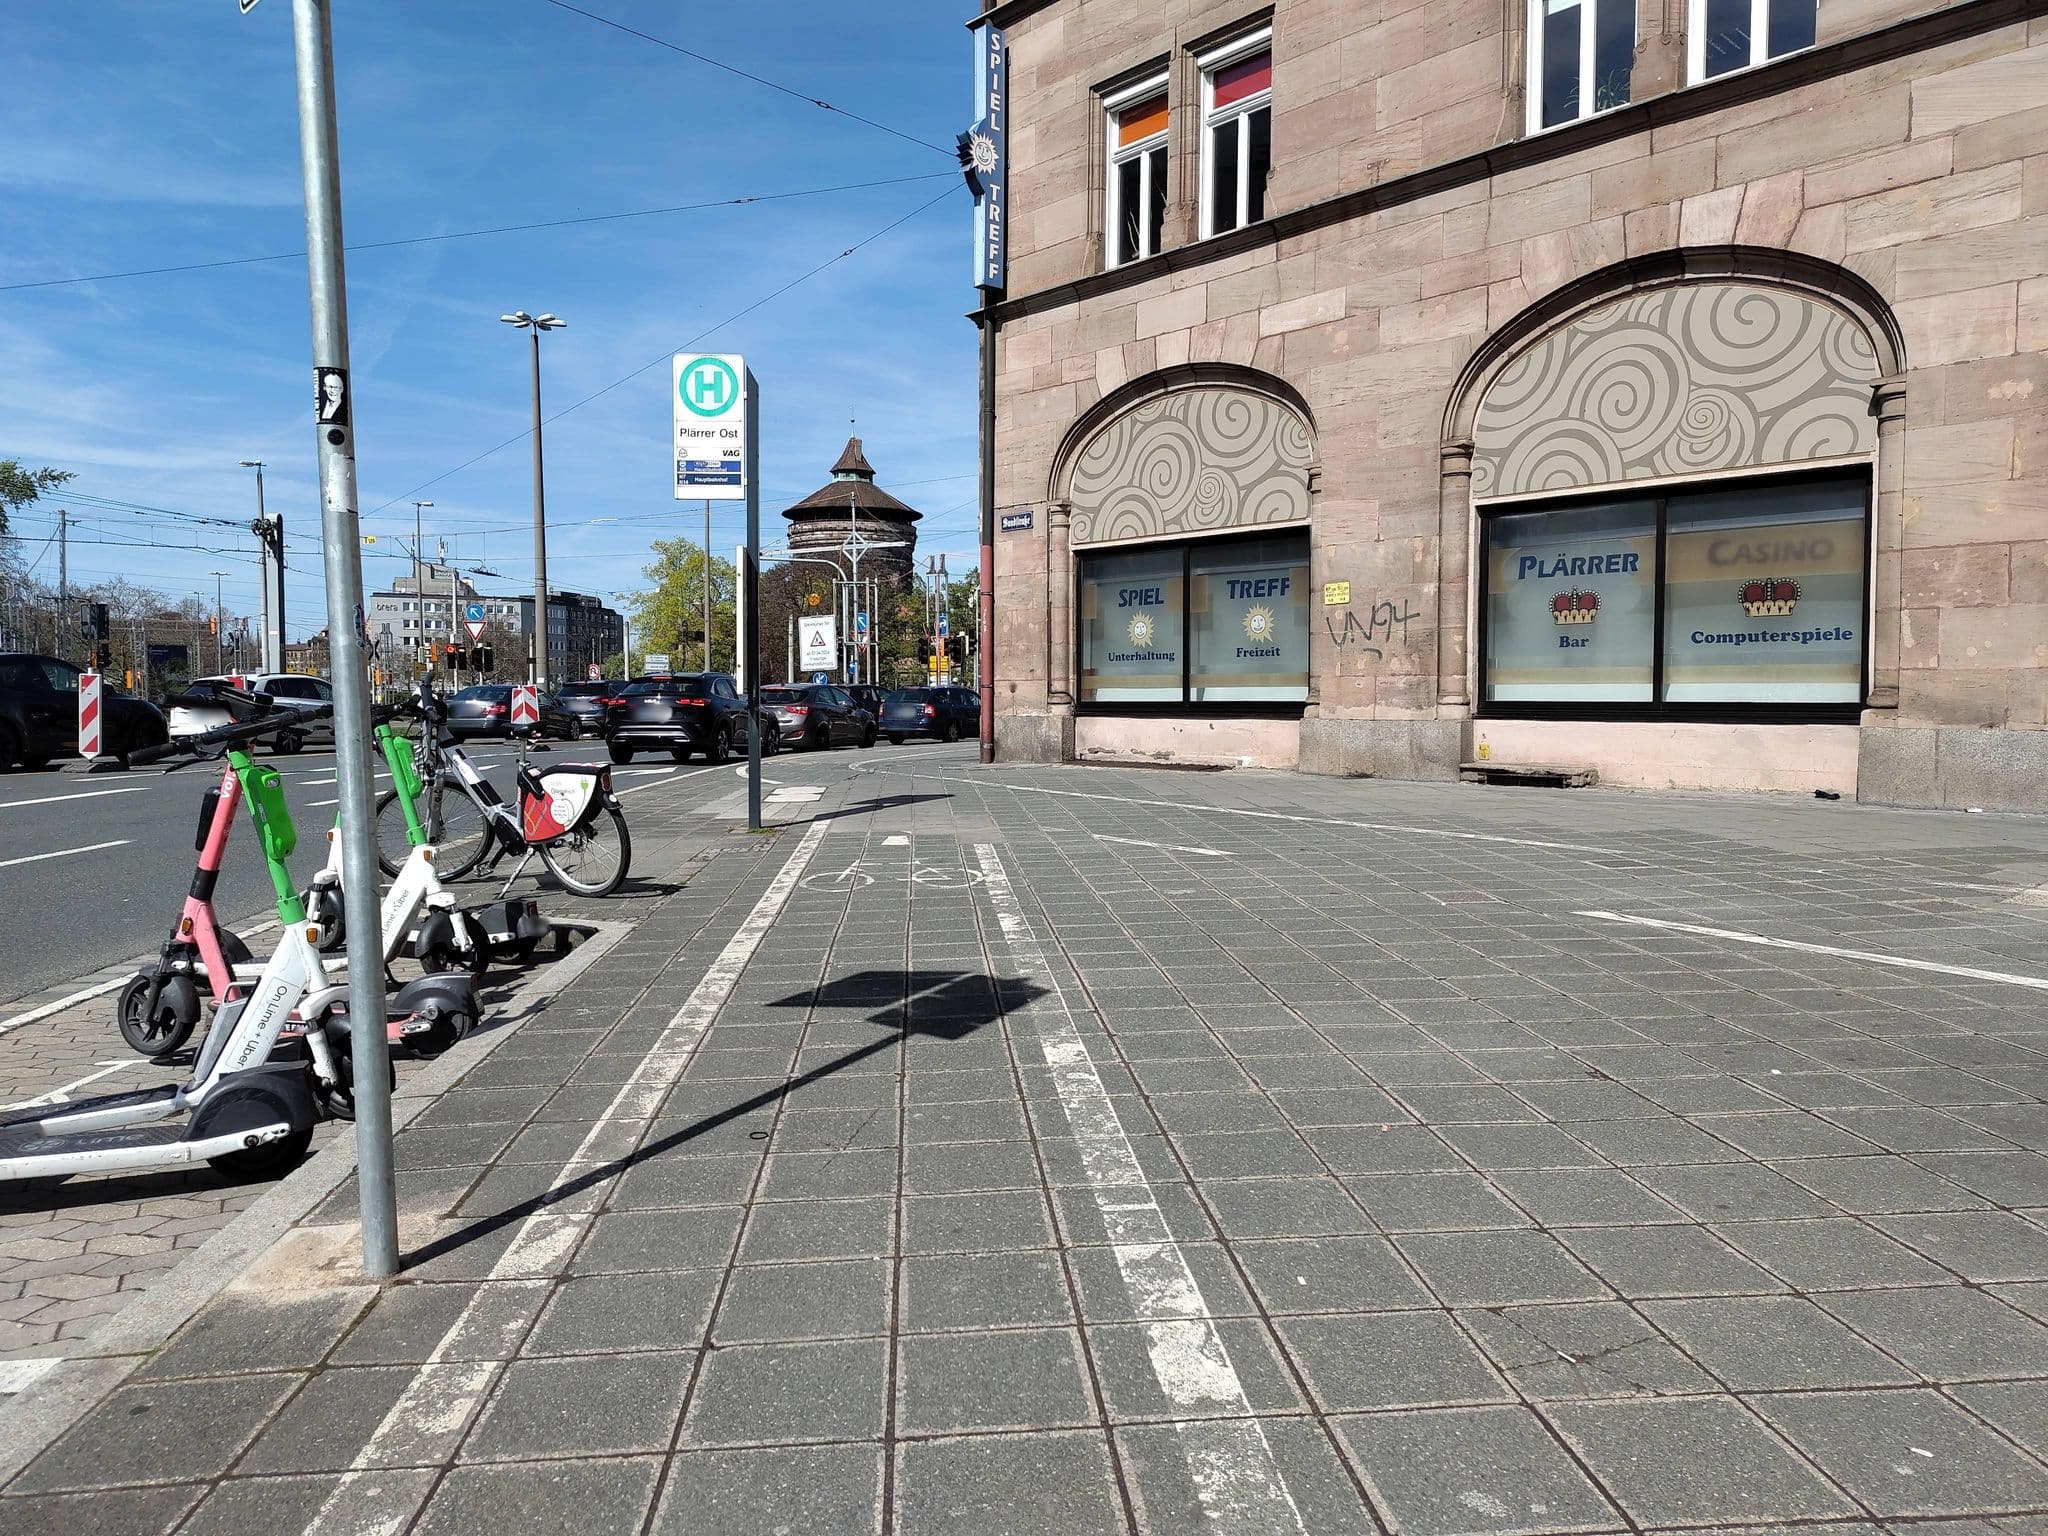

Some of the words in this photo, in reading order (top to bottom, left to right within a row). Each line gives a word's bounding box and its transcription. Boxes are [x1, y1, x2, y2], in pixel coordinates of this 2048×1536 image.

[990, 33, 1000, 131] SPIEL
[989, 184, 1000, 279] TREFF
[679, 428, 716, 438] Plärrer
[719, 428, 738, 438] Ost
[722, 449, 740, 457] VAG
[1708, 537, 1834, 565] CASINO
[1518, 552, 1640, 580] PLÄRRER
[1118, 587, 1165, 607] SPIEL
[1226, 577, 1290, 600] TREFF
[1558, 635, 1590, 648] Bar
[1691, 627, 1854, 645] Computerspiele
[1108, 650, 1176, 663] Unterhaltung
[1236, 646, 1281, 658] Freizeit
[271, 985, 288, 1002] On
[257, 1003, 280, 1030] Lime
[237, 1040, 260, 1067] Uber
